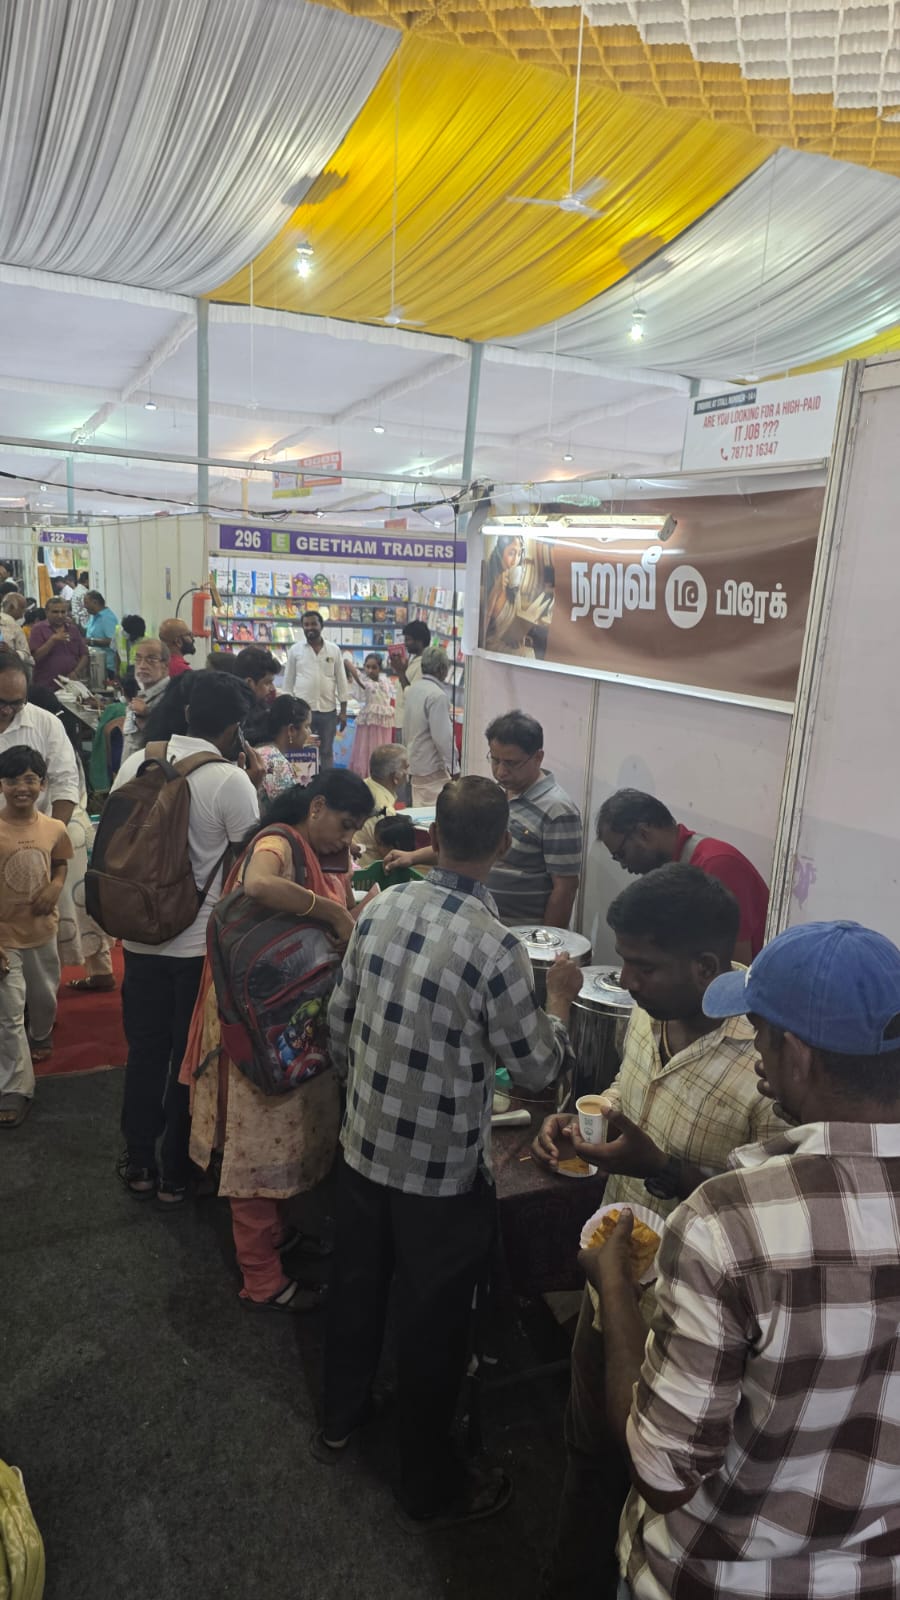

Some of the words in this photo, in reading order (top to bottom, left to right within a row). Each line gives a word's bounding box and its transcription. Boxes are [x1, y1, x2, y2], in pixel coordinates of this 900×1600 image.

[704, 415, 715, 428] ARE
[717, 412, 729, 426] YOU
[730, 406, 760, 423] LOOKING
[760, 403, 774, 419] FOR
[775, 402, 781, 417] A
[782, 396, 822, 415] HIGH-PAID
[734, 425, 743, 442] IT
[744, 422, 760, 441] JOB
[762, 420, 779, 439] ???
[234, 529, 261, 548] 296
[276, 532, 286, 548] E
[296, 536, 377, 555] GEETHAM
[382, 541, 455, 559] TRADERS
[570, 545, 663, 629] நறுவீ
[716, 579, 788, 624] பிரேக்
